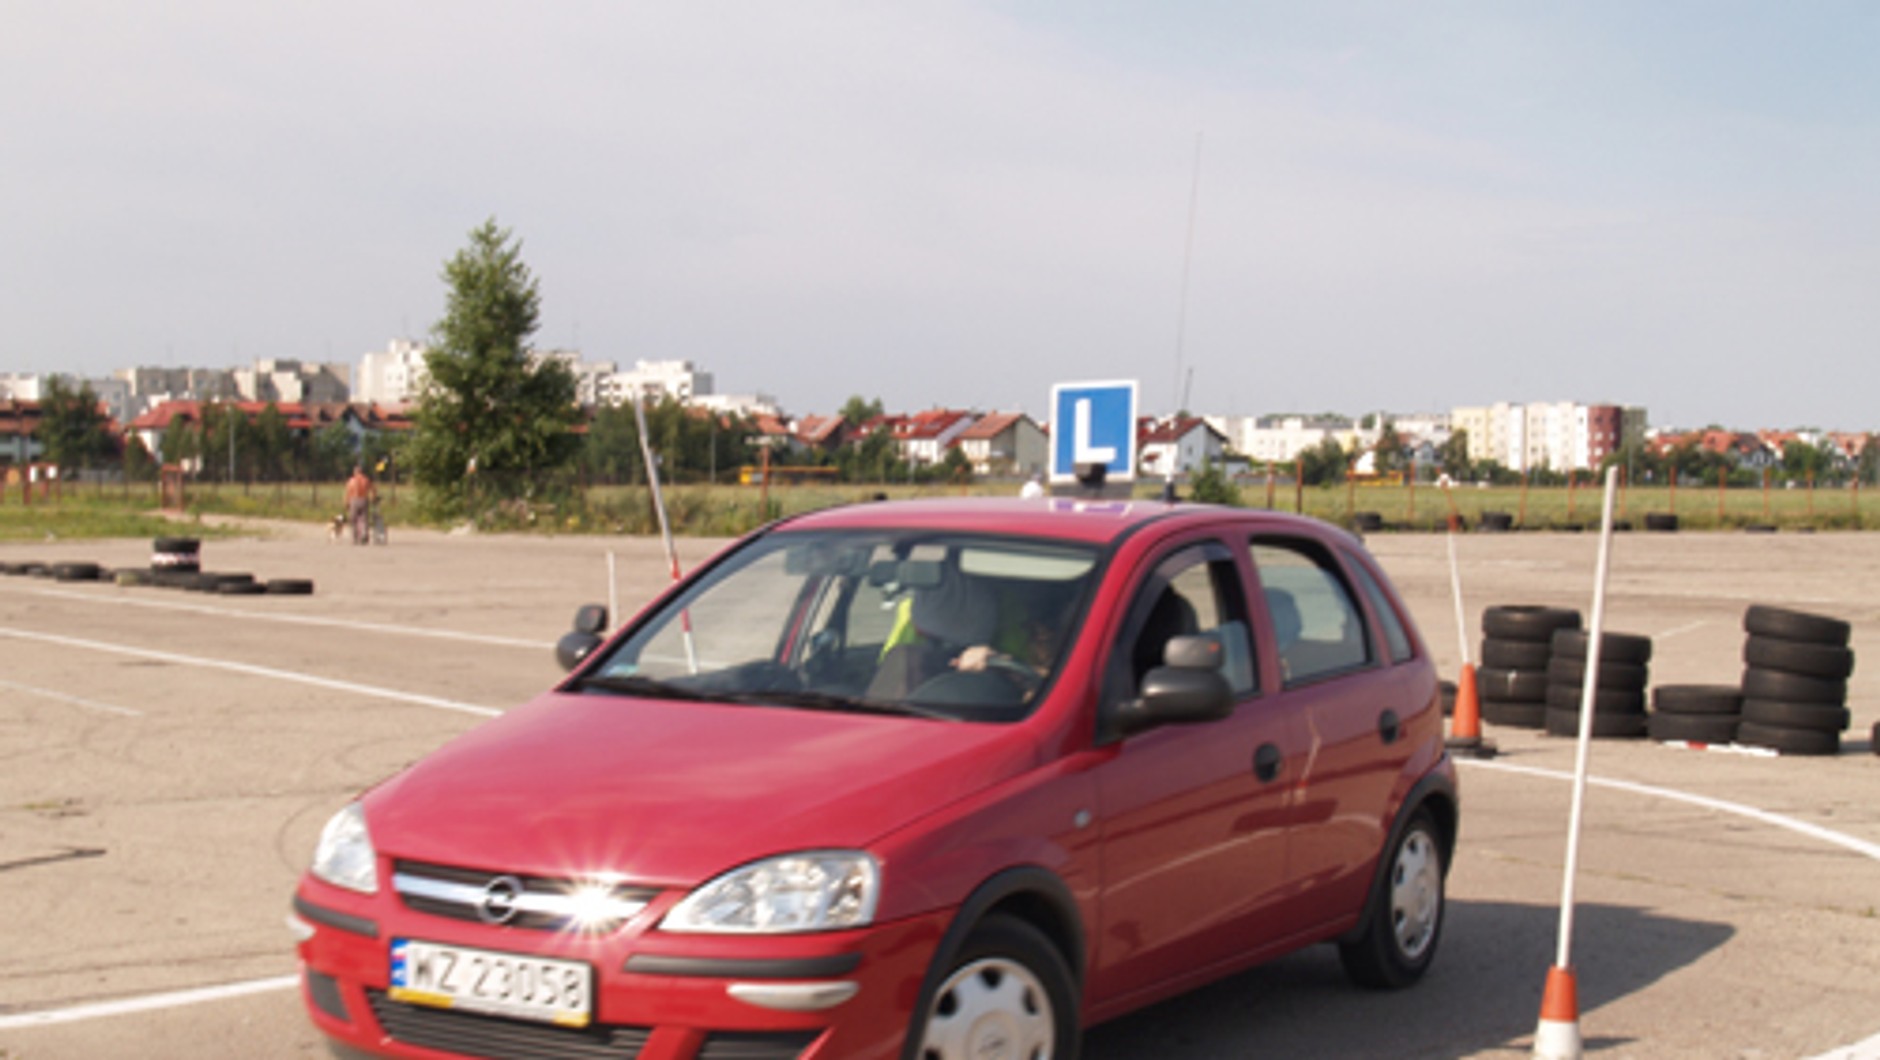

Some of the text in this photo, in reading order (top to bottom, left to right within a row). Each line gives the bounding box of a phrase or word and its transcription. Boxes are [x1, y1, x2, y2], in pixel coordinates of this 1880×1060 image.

[1075, 399, 1116, 463] L
[413, 951, 582, 1008] WZ 23058
